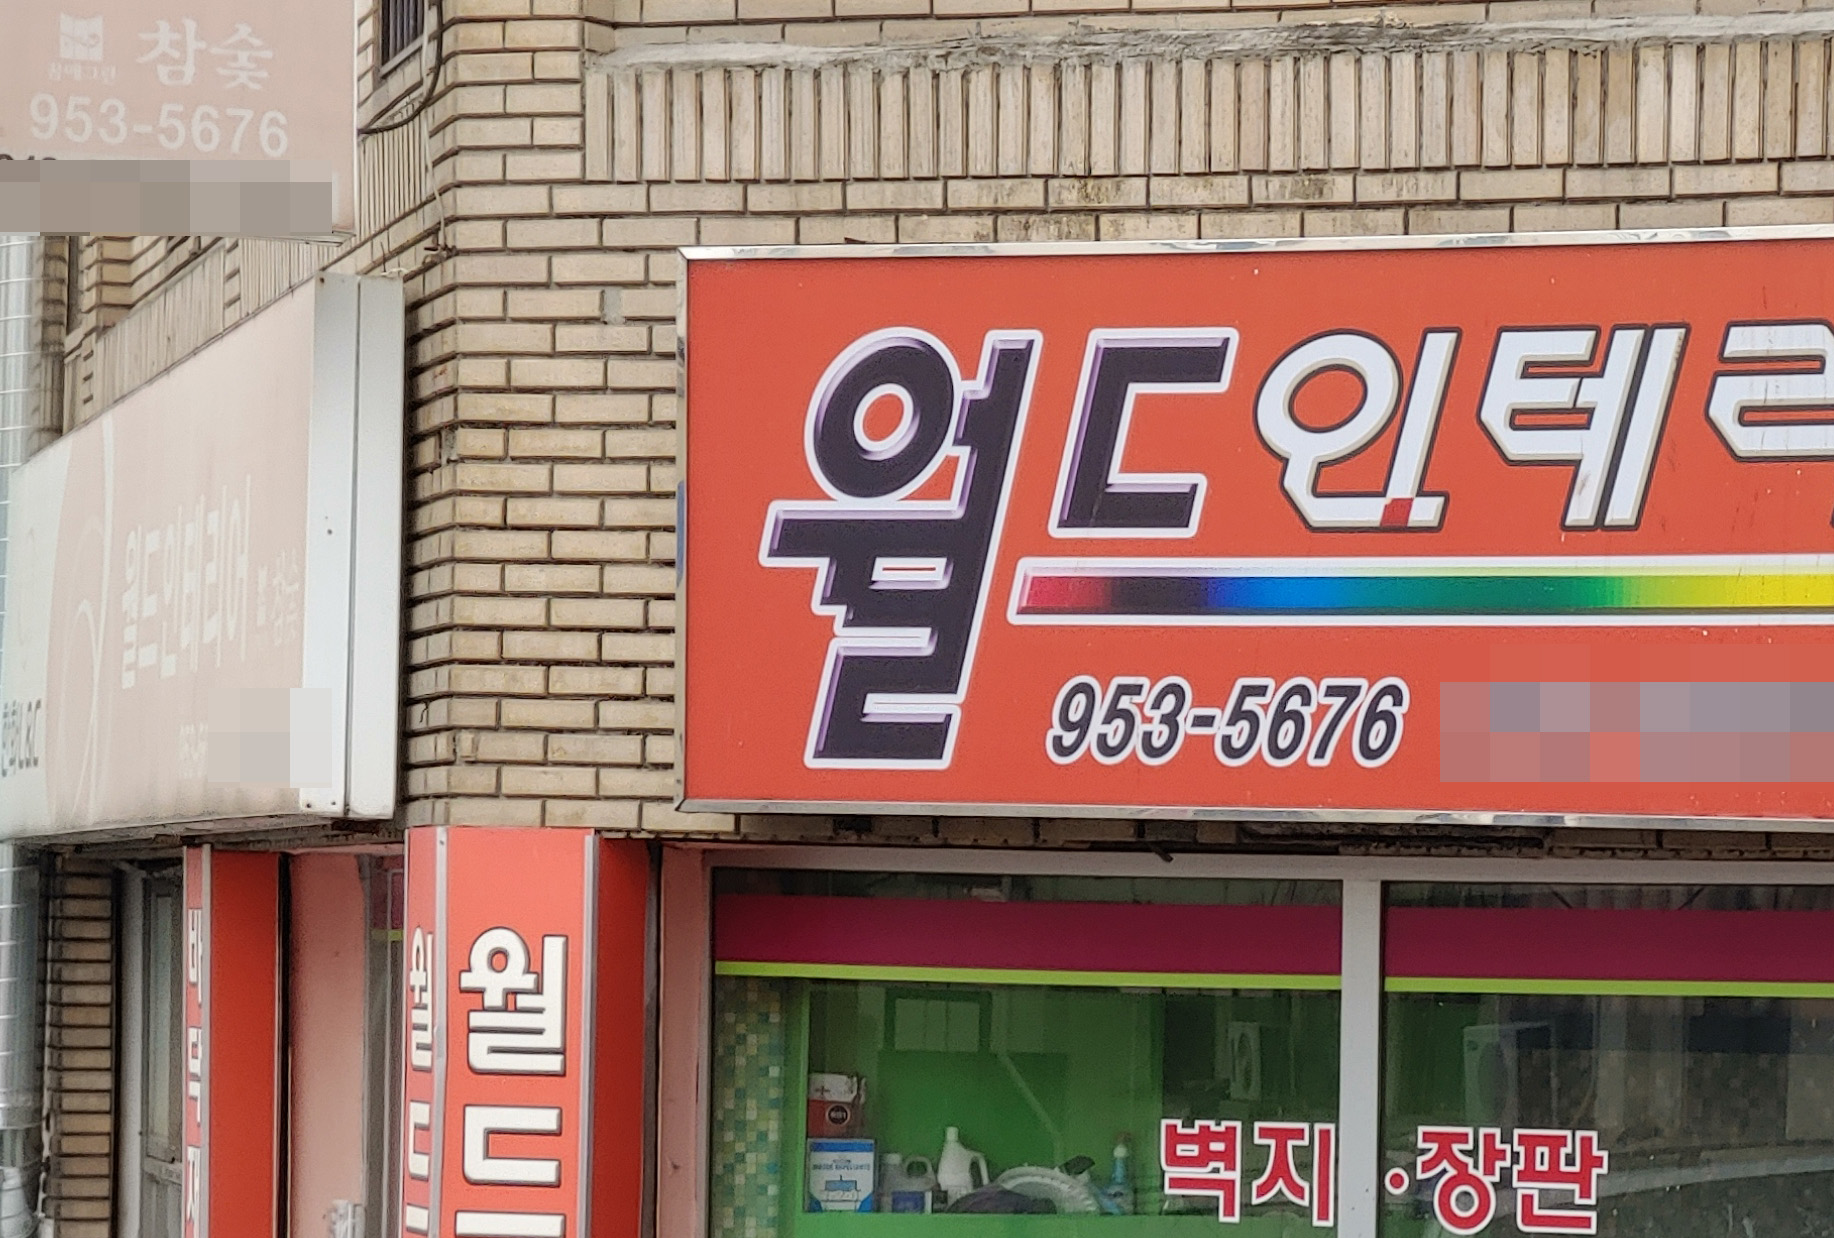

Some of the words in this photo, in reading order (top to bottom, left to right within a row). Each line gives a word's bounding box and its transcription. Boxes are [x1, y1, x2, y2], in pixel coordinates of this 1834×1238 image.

[135, 17, 274, 91] 참숯
[28, 92, 289, 158] 953-5676
[121, 473, 251, 690] 월드인테리어
[1046, 675, 1409, 767] 953-5676
